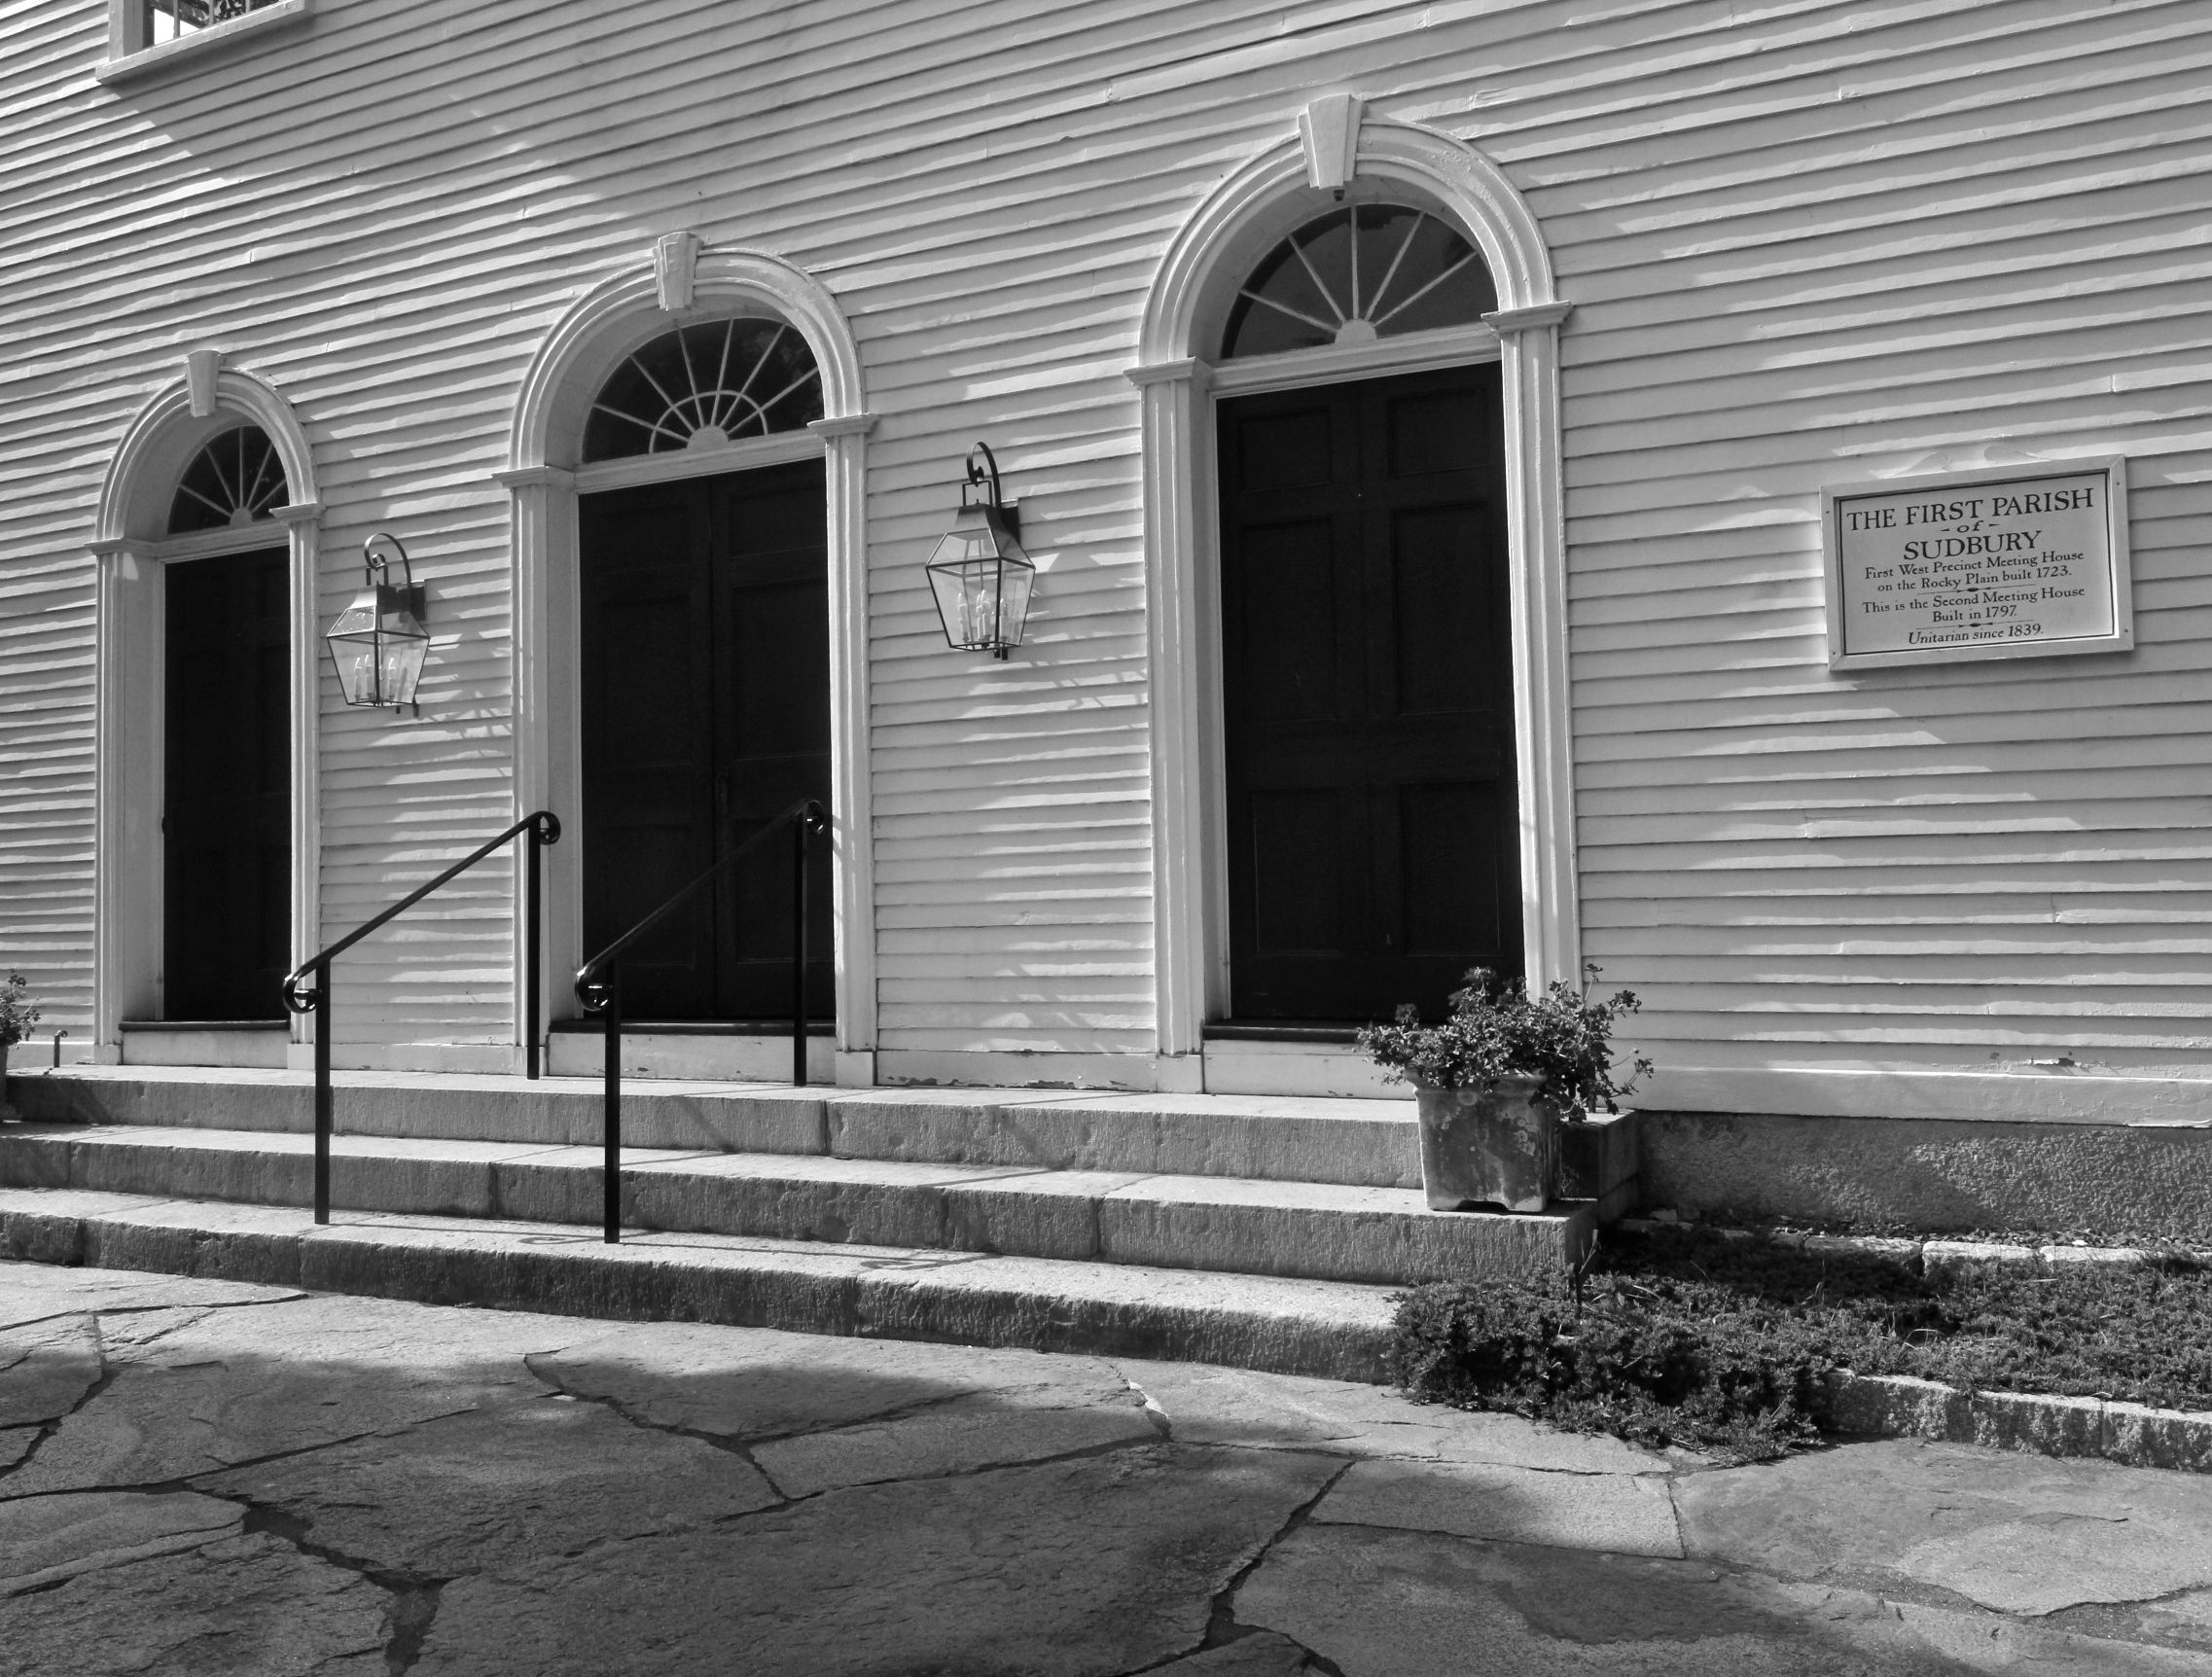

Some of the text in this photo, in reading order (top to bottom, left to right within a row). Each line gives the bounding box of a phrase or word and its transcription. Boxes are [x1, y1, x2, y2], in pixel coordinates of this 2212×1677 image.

[1847, 487, 2093, 531] THE FIRST PARISH
[1956, 520, 1984, 533] of
[1903, 530, 2043, 560] SUDBURY
[1865, 551, 2085, 579] First West Precinct Meeting House
[1898, 580, 1916, 590] the
[1921, 577, 1961, 589] Rocky
[1966, 572, 1999, 585] Plain
[2002, 569, 2031, 582] built
[2037, 565, 2072, 578] 1723.
[1862, 587, 2085, 614] This is the Second Meeting House
[1933, 610, 1963, 623] Built
[1969, 608, 1981, 620] in
[1909, 629, 1969, 644] Unitarian
[1973, 627, 2005, 640] since
